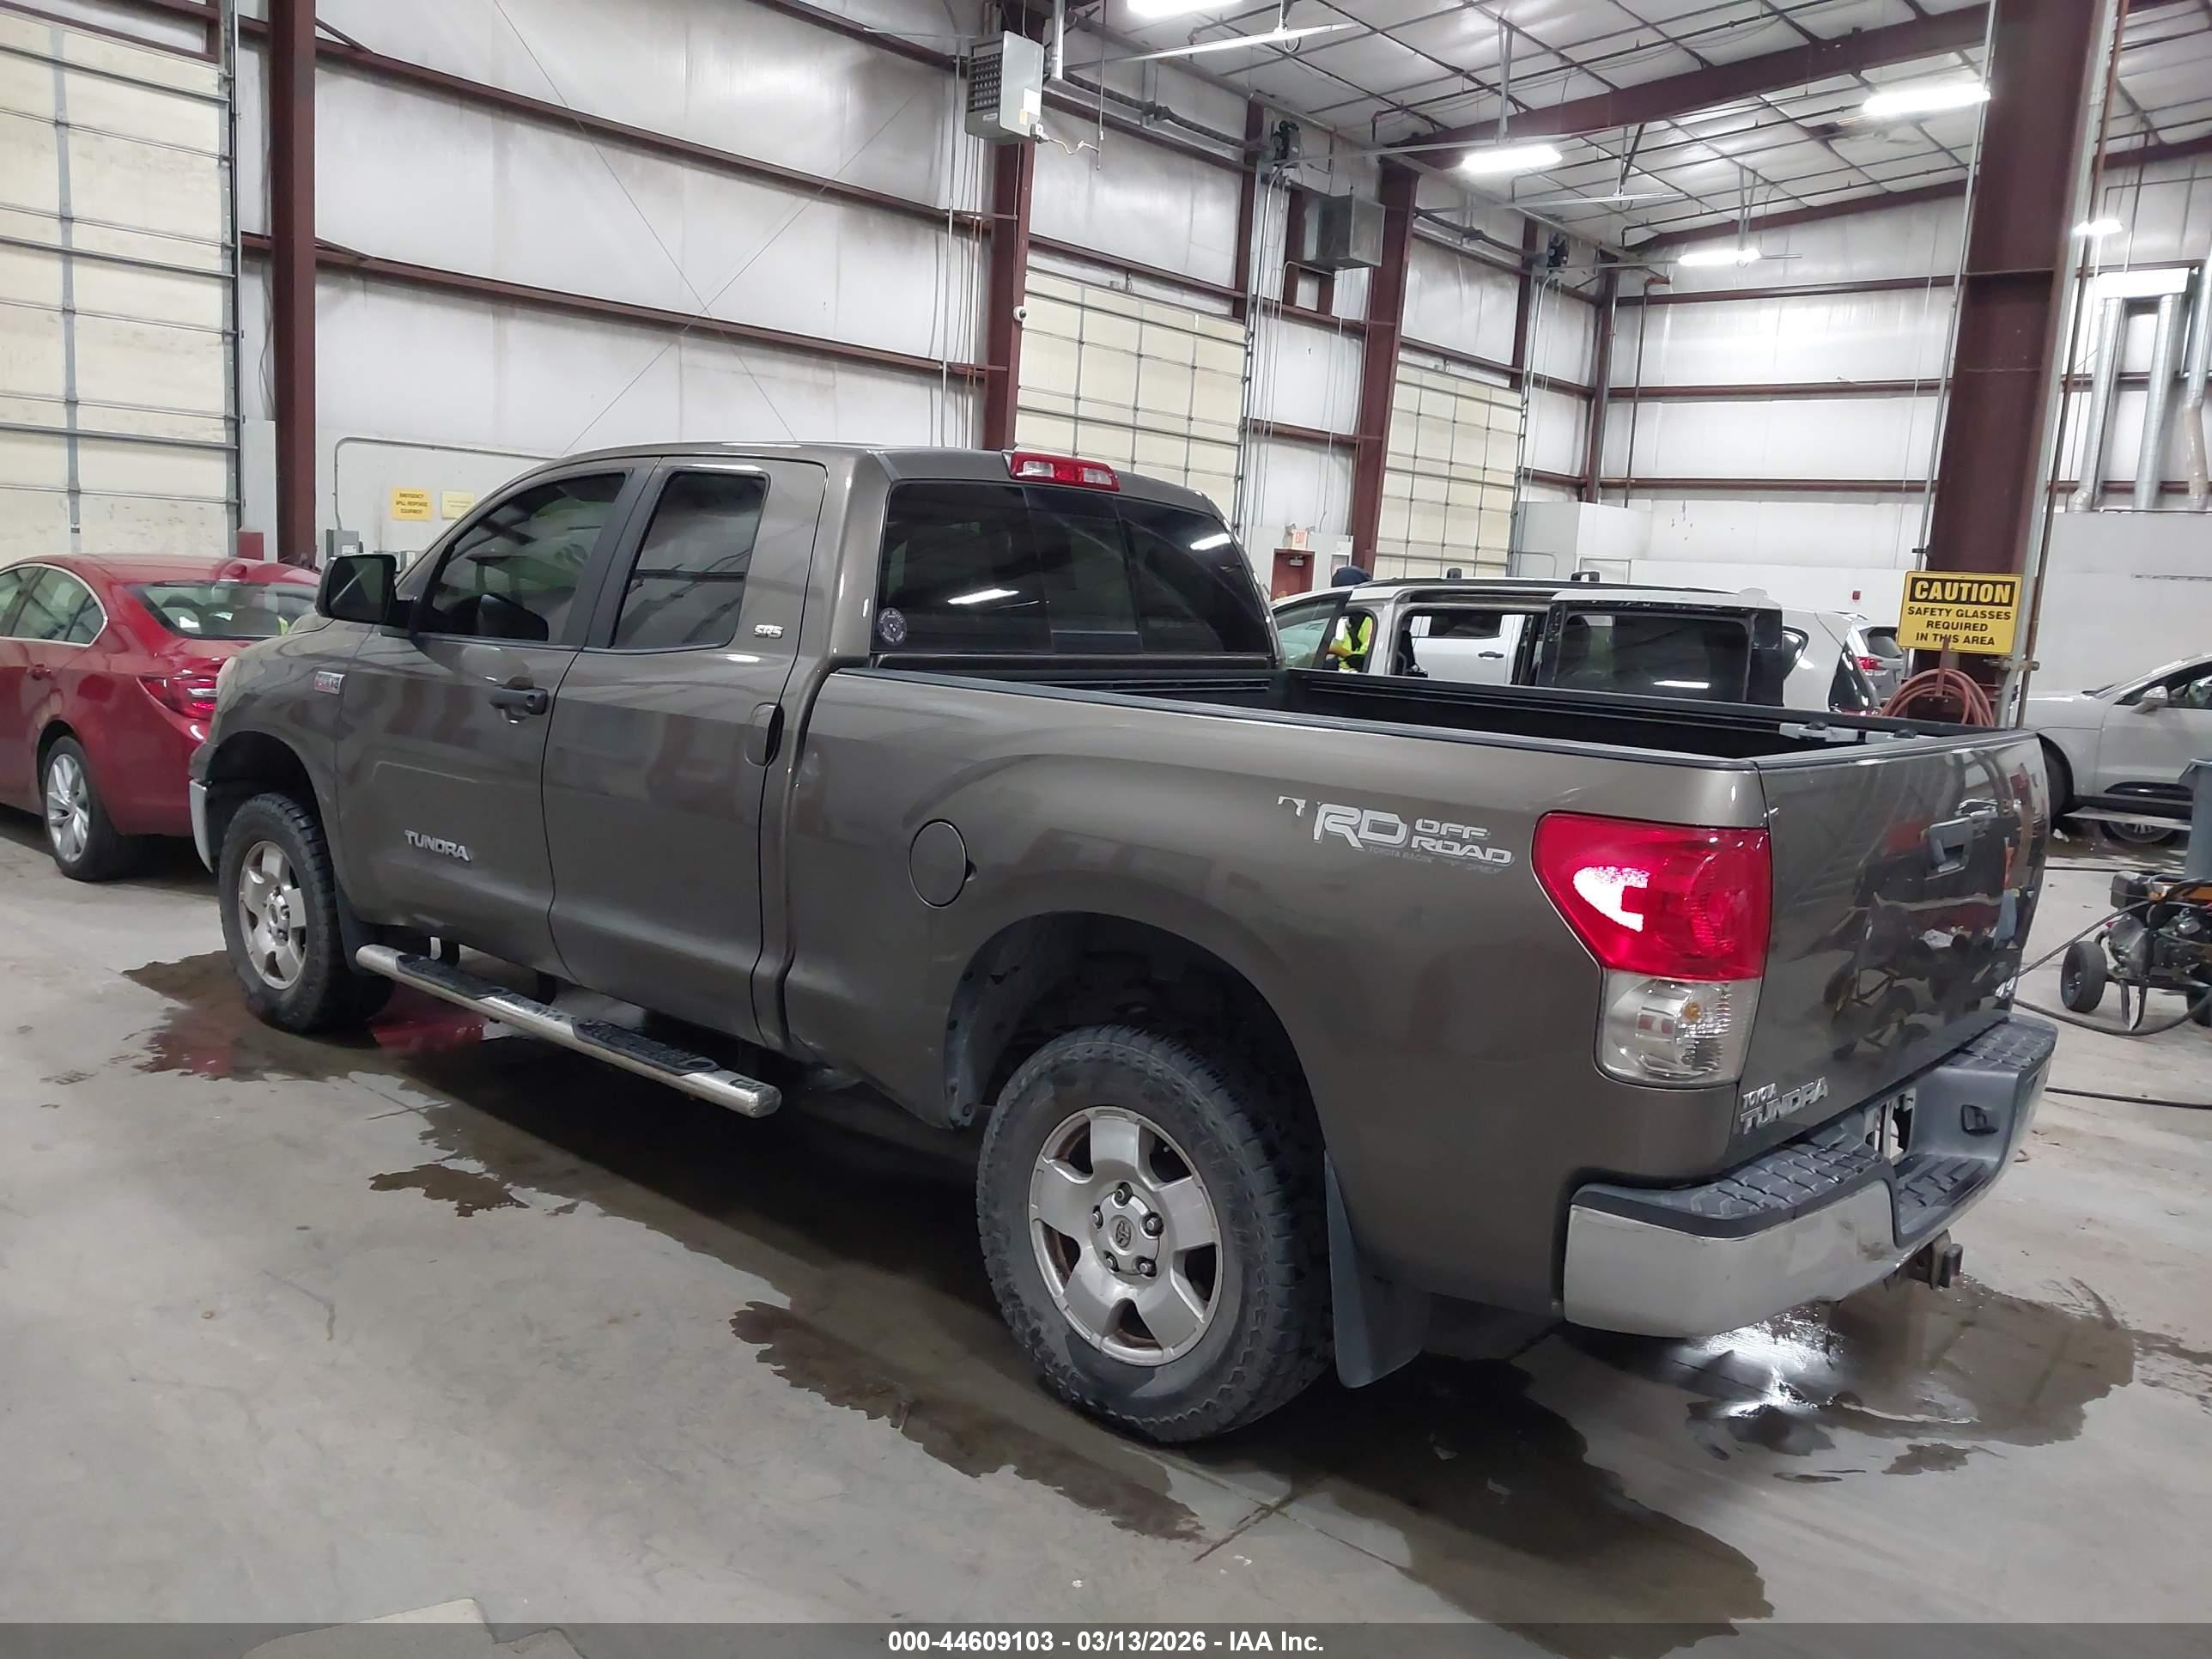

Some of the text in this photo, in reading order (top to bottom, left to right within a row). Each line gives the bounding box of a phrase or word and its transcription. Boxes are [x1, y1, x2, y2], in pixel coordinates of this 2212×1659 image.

[1914, 580, 2011, 604] CAUTION
[1907, 606, 2011, 620] SAFETY GLASSES
[1926, 620, 1988, 632] REQUIRED
[1915, 632, 1929, 641] IN
[1962, 635, 1995, 646] AREA
[1415, 818, 1489, 840] OFF
[405, 830, 470, 861] TUNDRA
[1411, 836, 1513, 865] ROAD
[1740, 1077, 1828, 1134] TUNDRA
